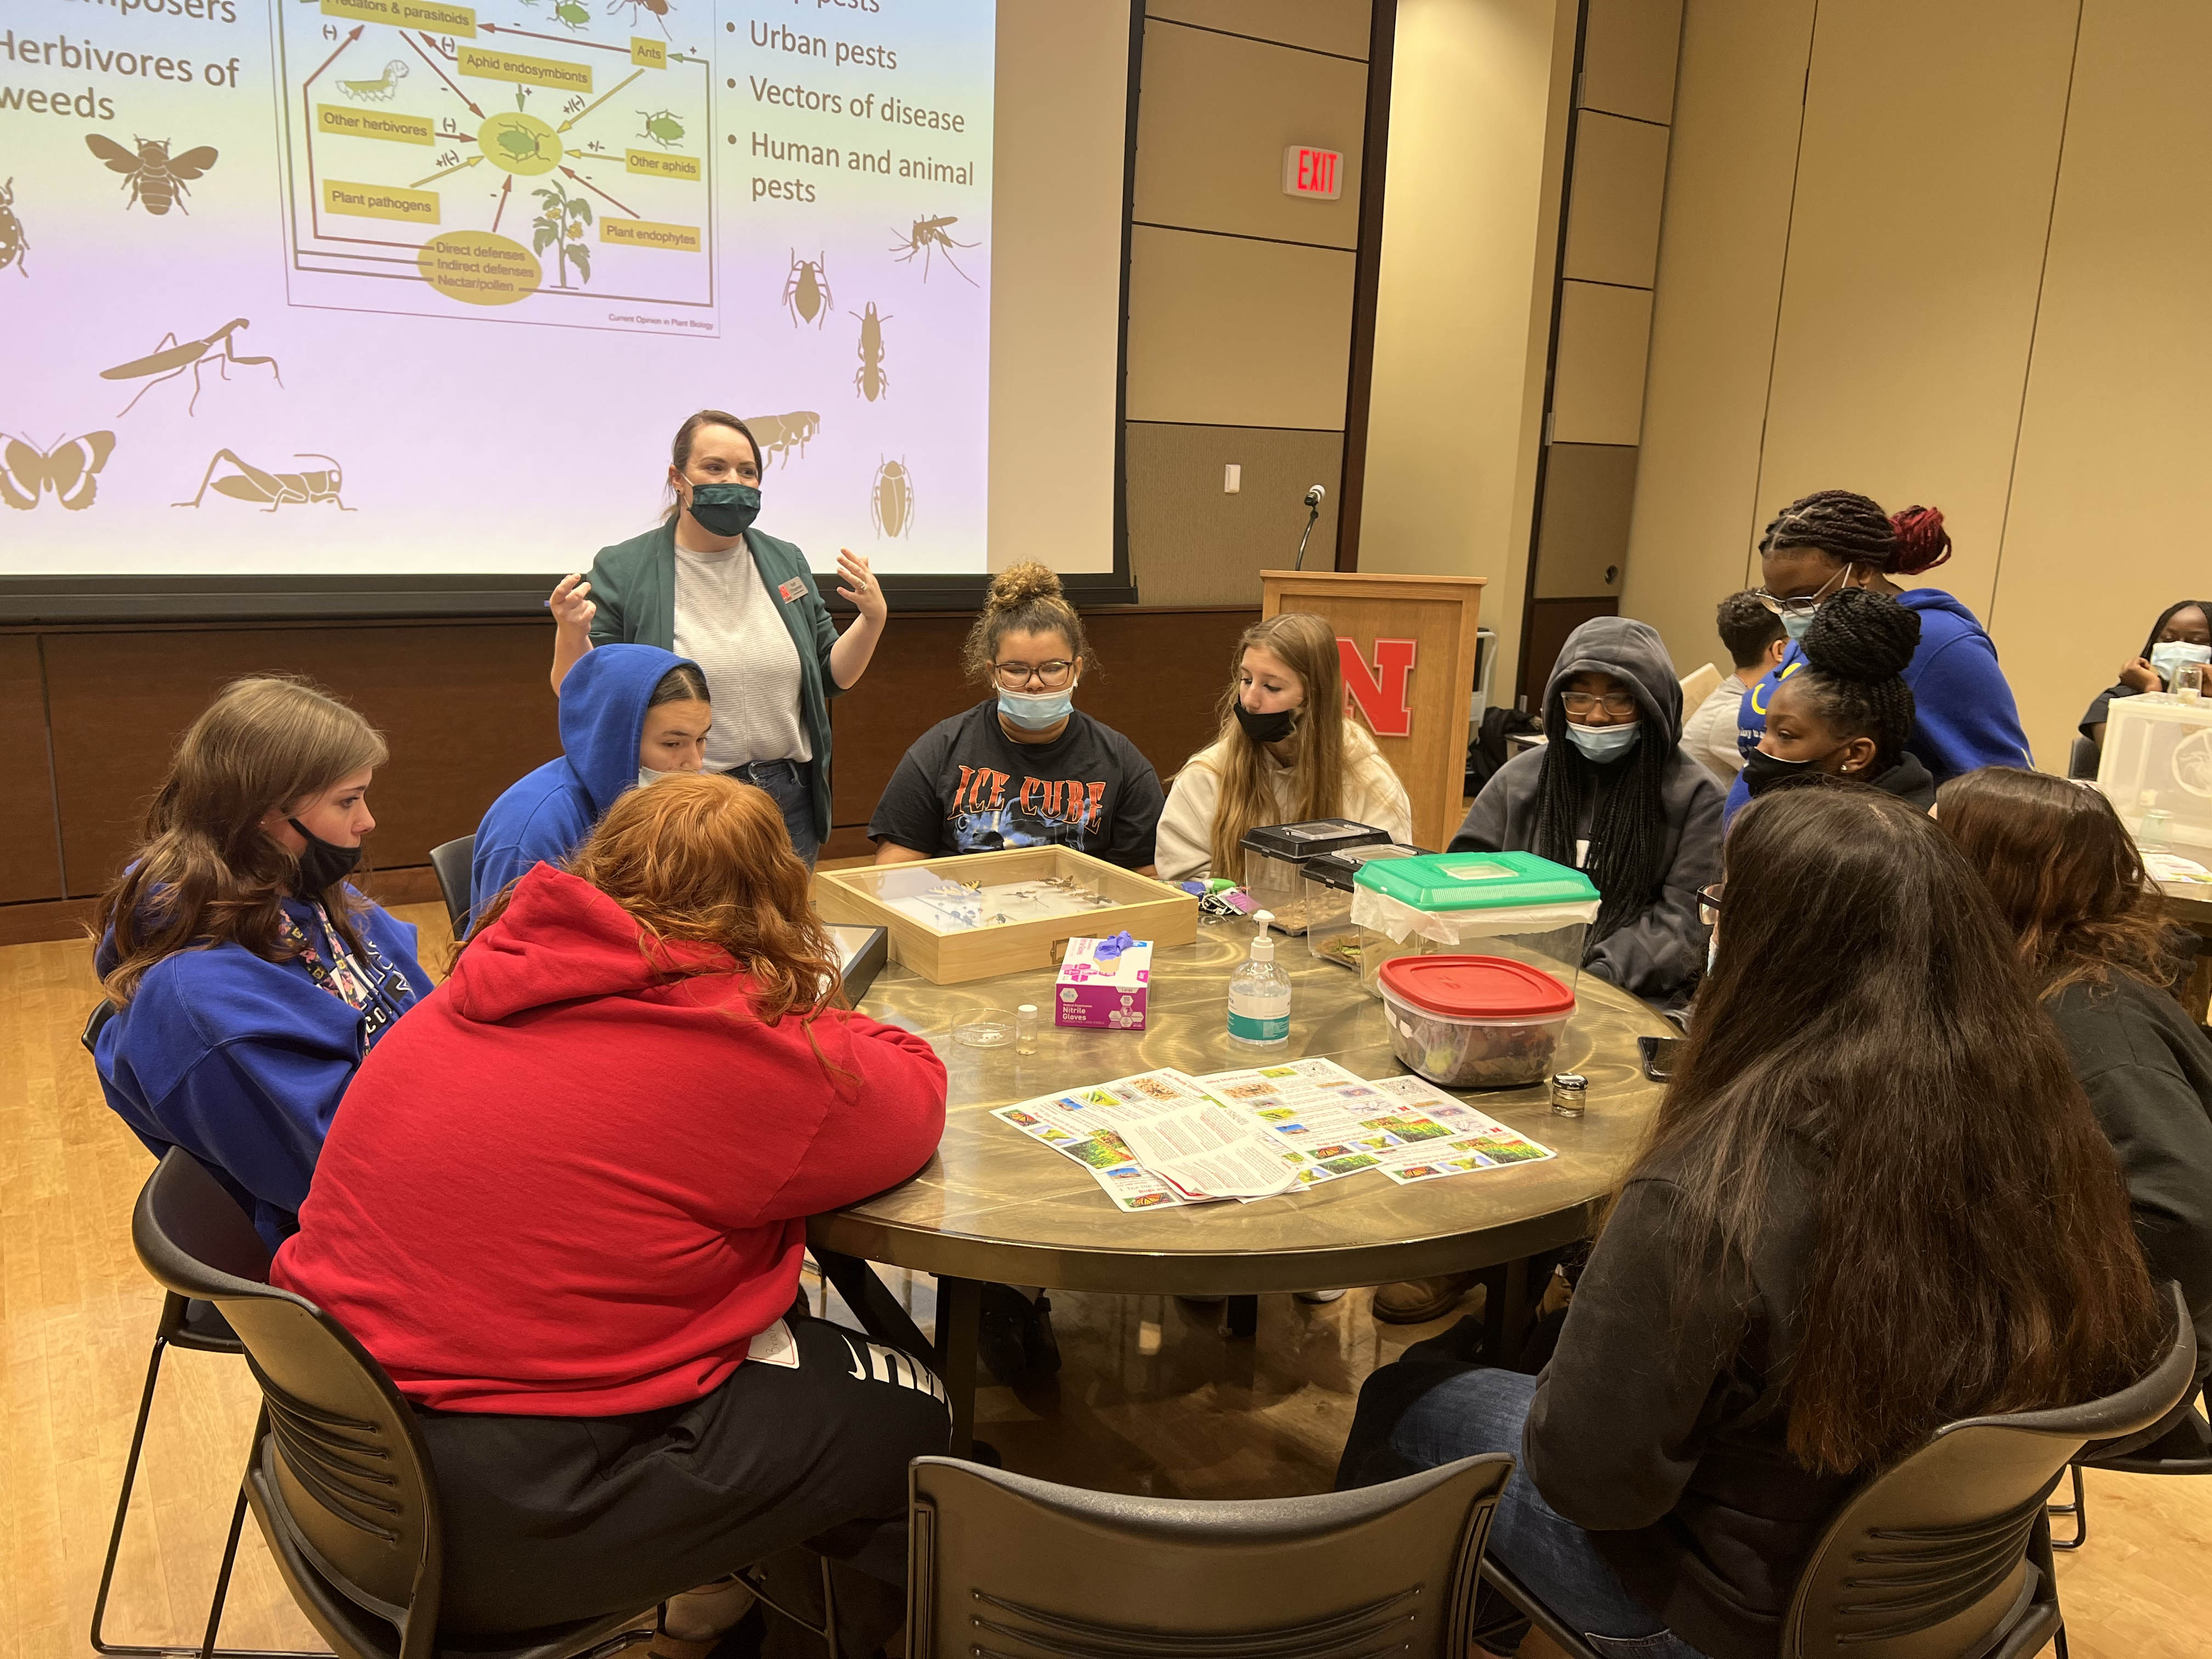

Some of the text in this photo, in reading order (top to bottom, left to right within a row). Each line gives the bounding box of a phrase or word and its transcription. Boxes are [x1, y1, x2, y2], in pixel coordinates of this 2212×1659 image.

[326, 0, 470, 26] redators & parasitoids
[637, 45, 662, 60] Ants
[751, 20, 898, 70] Urban pests
[0, 29, 240, 88] Herbivores of
[466, 54, 588, 84] Aphid endosymbionts
[0, 86, 115, 120] weeds
[749, 75, 965, 133] Vectors of disease
[324, 112, 427, 137] Other herbivores
[630, 155, 696, 174] Other aphids
[752, 131, 974, 185] Human and animal
[1297, 149, 1338, 194] EXIT
[331, 190, 432, 213] Plant pathogens
[752, 177, 816, 203] pests
[606, 225, 696, 245] Plant endophytes
[436, 241, 526, 261] Direct defenses
[437, 258, 534, 278] Indirect defenses
[437, 274, 514, 291] Nectar/pollen
[608, 313, 634, 322] Current
[636, 315, 662, 324] Opinion
[671, 318, 688, 327] Plant
[690, 320, 714, 330] Biology
[1335, 636, 1417, 737] N
[947, 764, 1106, 835] ICE CUBE
